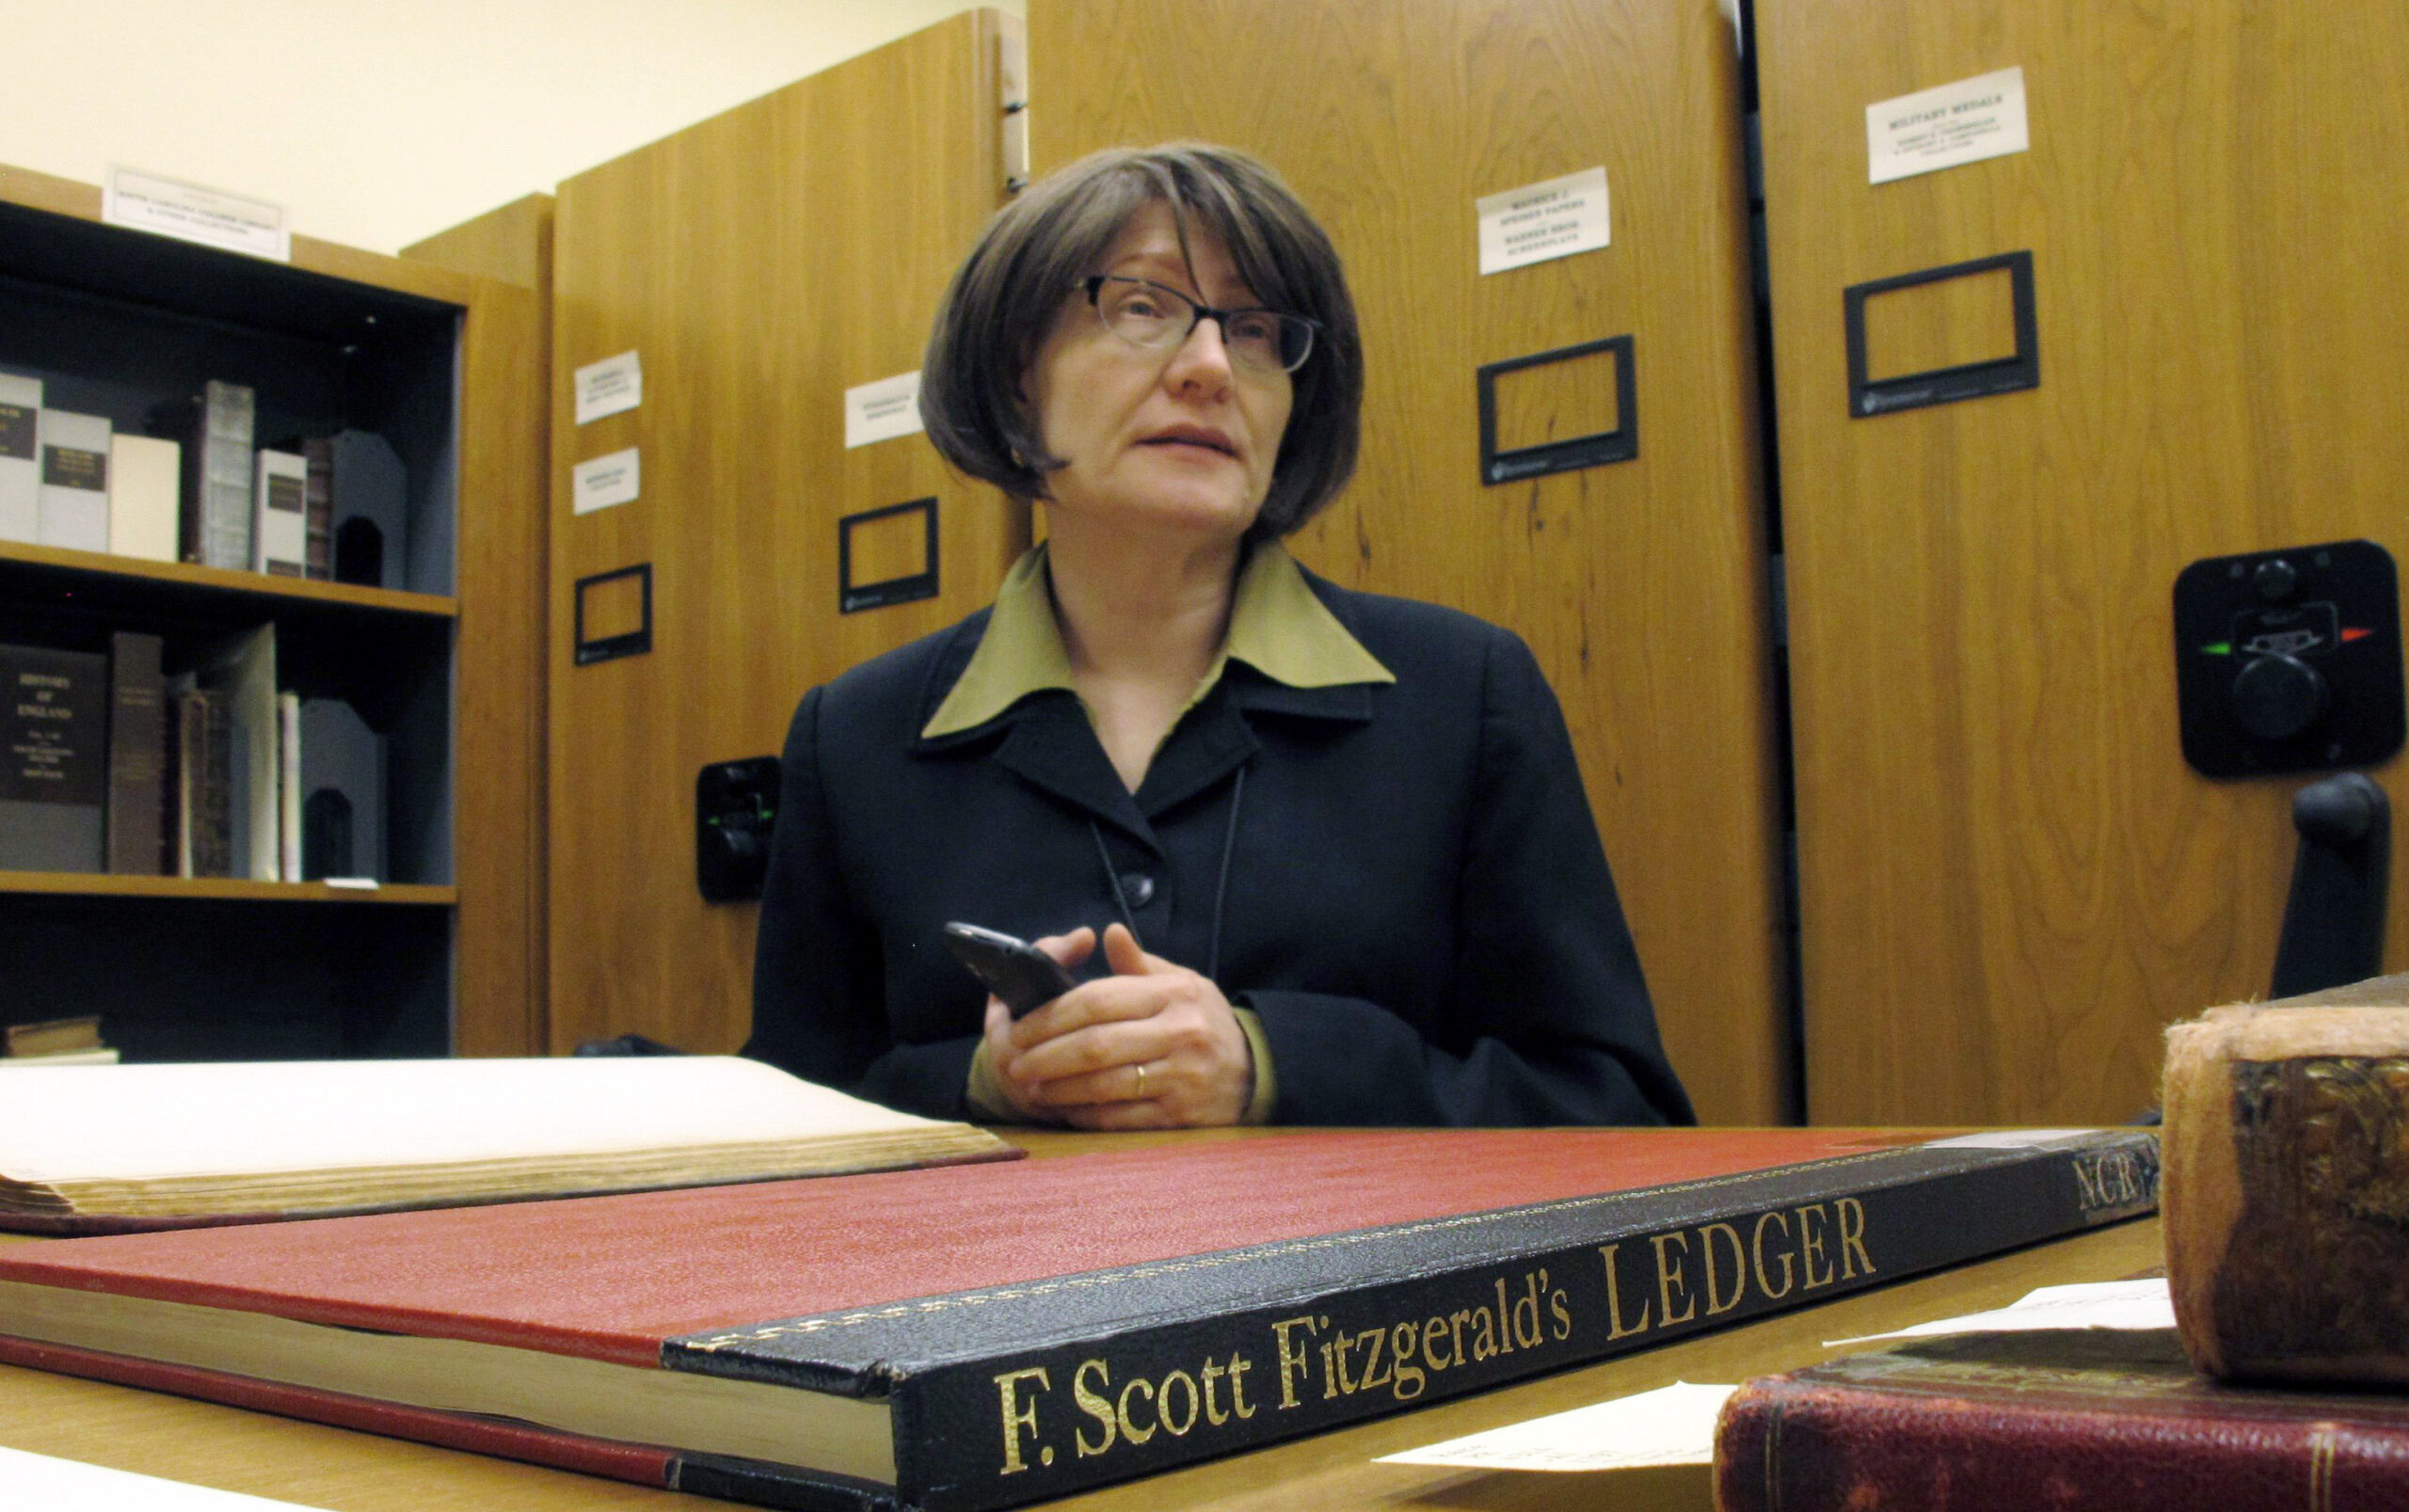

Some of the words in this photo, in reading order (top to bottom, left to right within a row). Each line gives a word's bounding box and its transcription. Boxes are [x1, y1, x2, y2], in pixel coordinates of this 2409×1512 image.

[1889, 108, 1946, 129] MILITARY
[1952, 94, 2002, 114] MEDALS
[17, 704, 72, 720] ENGLAND
[994, 1365, 1053, 1475] F.
[1074, 1351, 1256, 1458] Scott
[1271, 1267, 1571, 1410] Fitzgerald's
[1600, 1197, 1876, 1342] LEDGER
